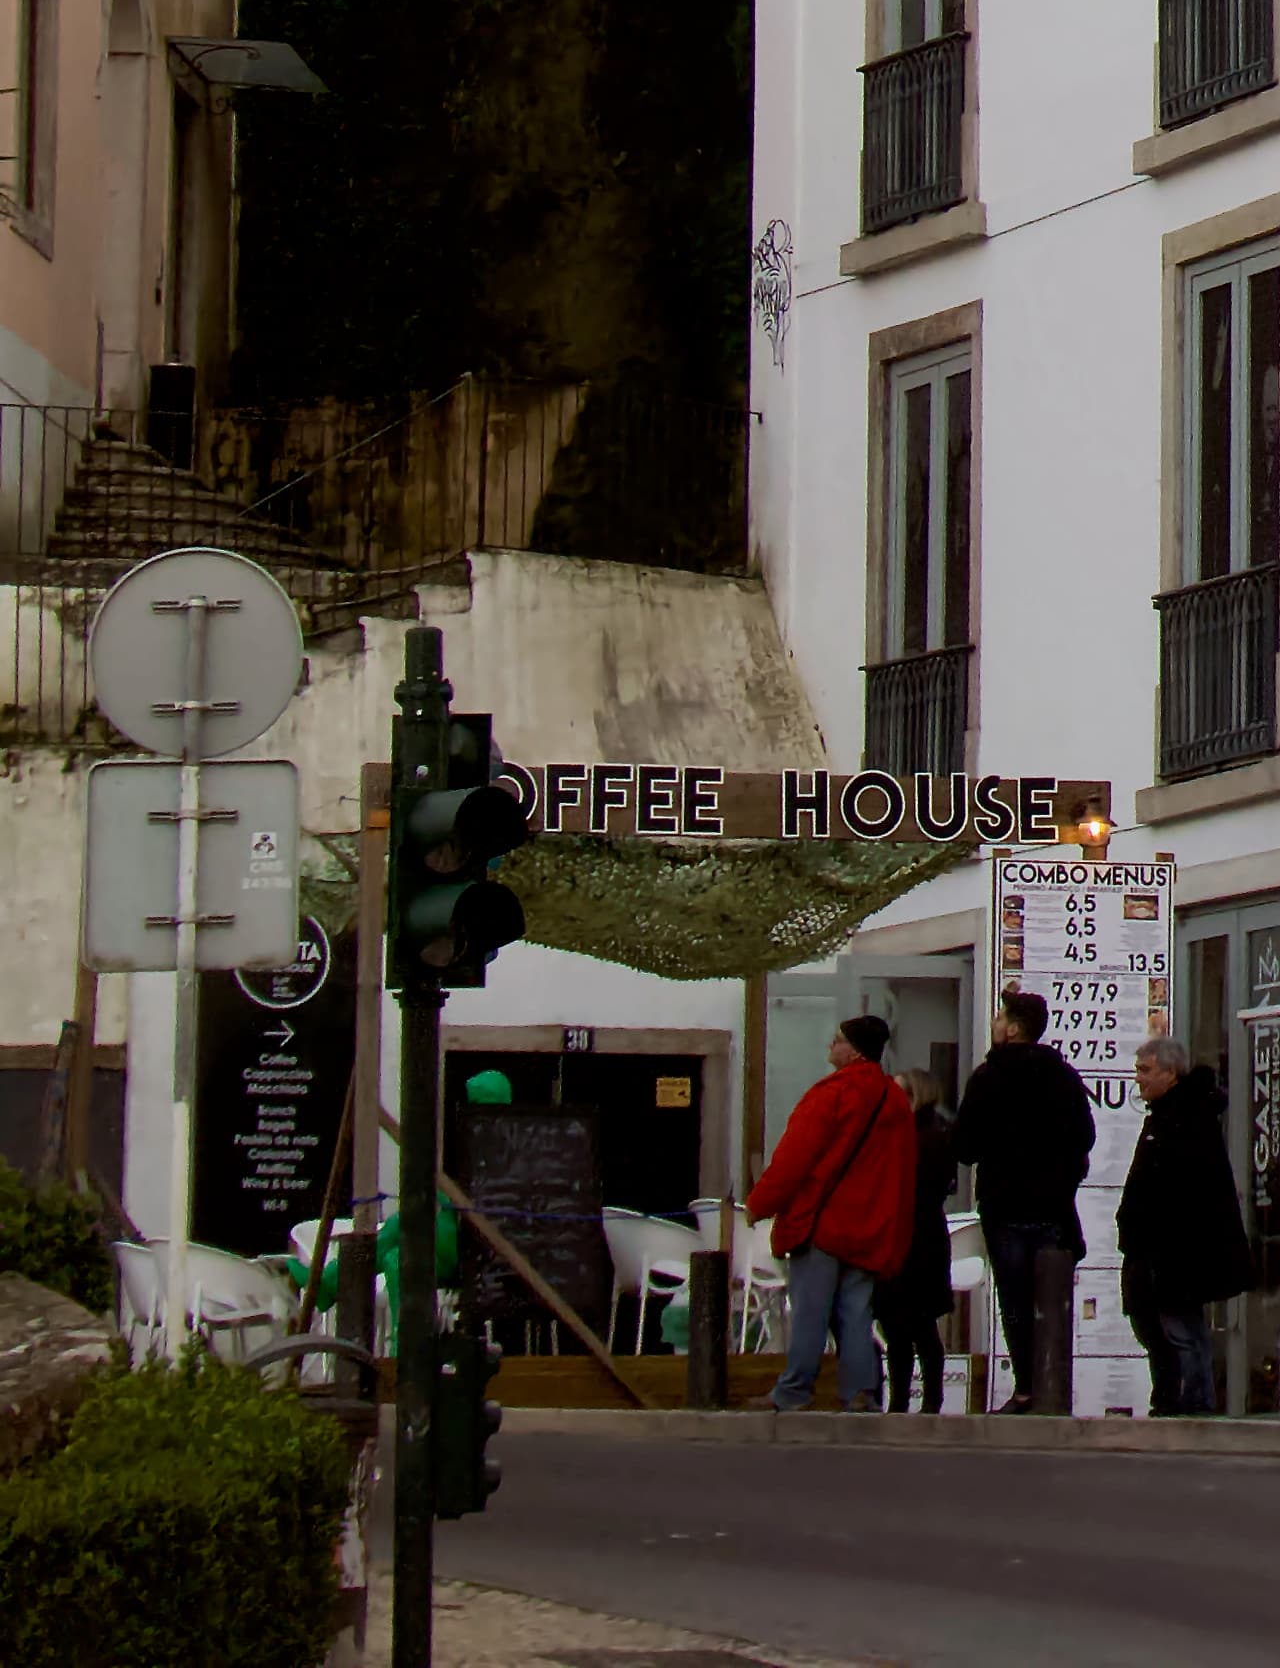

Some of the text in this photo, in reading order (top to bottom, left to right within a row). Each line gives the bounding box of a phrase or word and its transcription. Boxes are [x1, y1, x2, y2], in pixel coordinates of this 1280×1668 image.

[499, 760, 1059, 843] OFFEE HOUSE
[1003, 864, 1168, 887] COMBO MENUS
[1065, 894, 1096, 915] 6,5
[1065, 917, 1096, 938] 6,5
[1064, 943, 1097, 964] 4,5
[1128, 954, 1166, 975] 13,5
[1053, 982, 1118, 1004] 7,9 7,9
[1052, 1010, 1117, 1031] 7,9 7,5
[1086, 1040, 1117, 1061] 7,5
[1271, 1024, 1280, 1074] HOU
